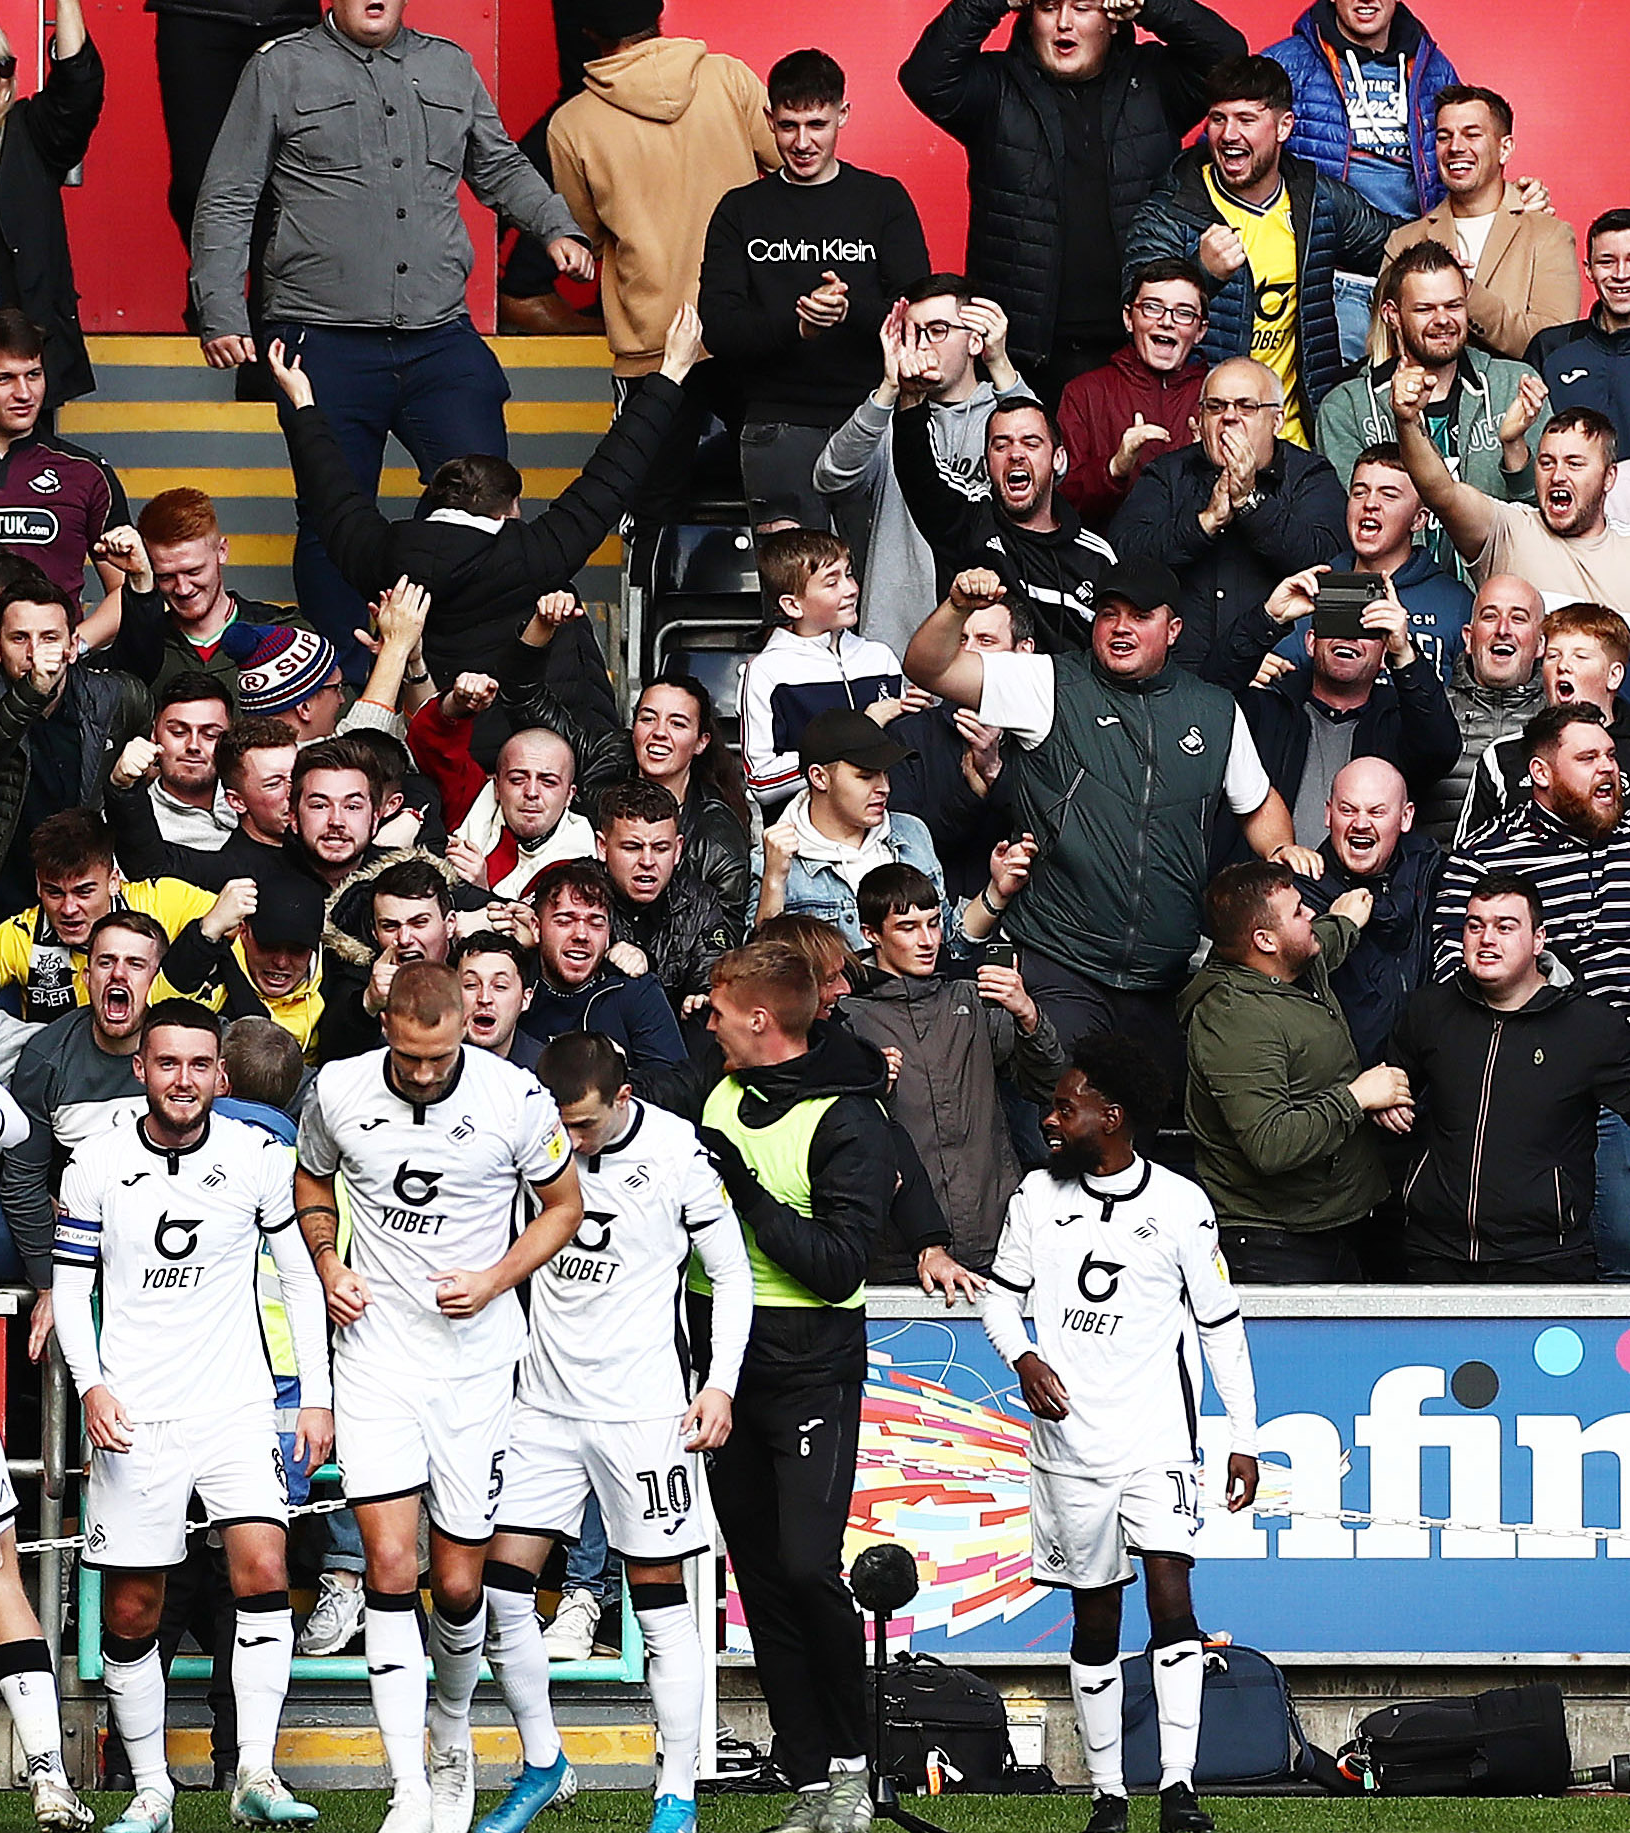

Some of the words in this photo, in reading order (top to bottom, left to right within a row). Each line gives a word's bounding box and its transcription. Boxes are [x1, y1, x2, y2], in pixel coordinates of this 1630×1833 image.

[747, 238, 819, 261] Calvin
[822, 238, 877, 261] Klein
[1250, 328, 1289, 350] OBET
[380, 1206, 448, 1236] YOBET
[142, 1266, 205, 1289] YOBET
[558, 1255, 621, 1285] YOBET
[1061, 1307, 1124, 1337] YOBET
[800, 1436, 810, 1457] 6
[637, 1465, 692, 1520] 10
